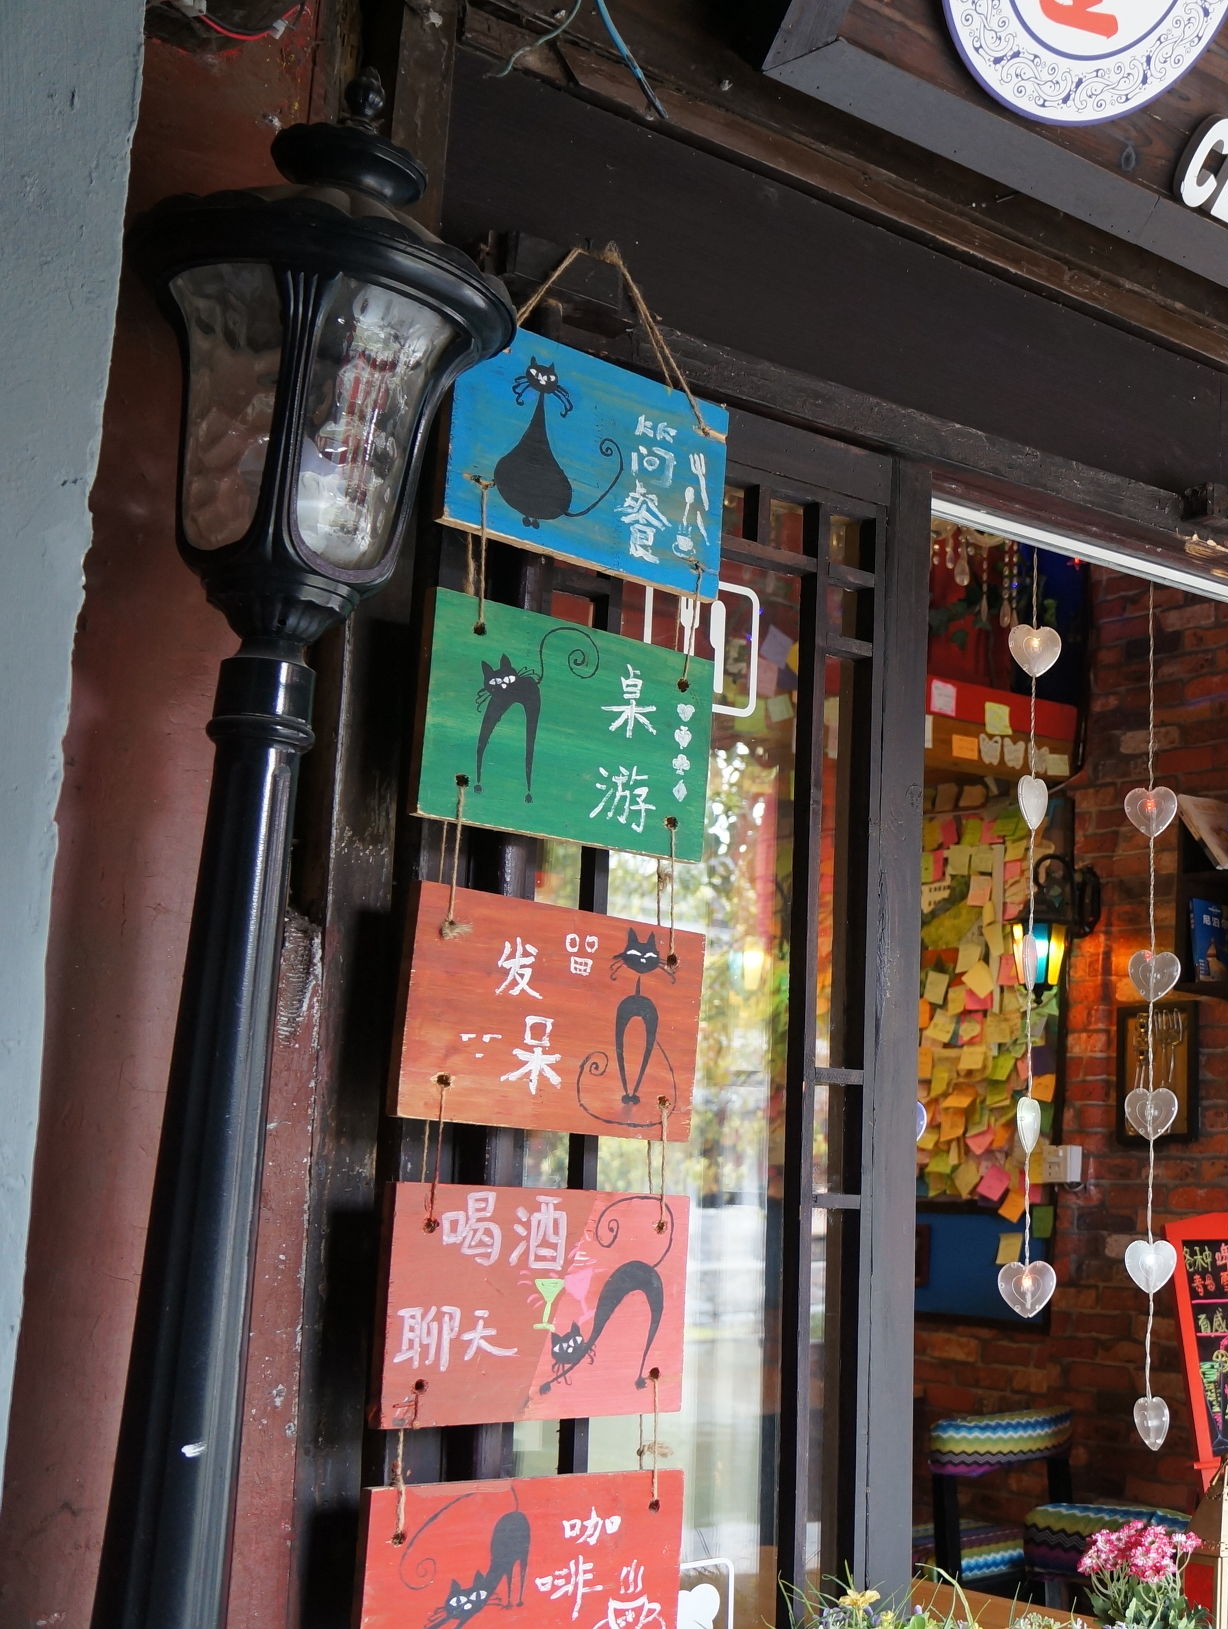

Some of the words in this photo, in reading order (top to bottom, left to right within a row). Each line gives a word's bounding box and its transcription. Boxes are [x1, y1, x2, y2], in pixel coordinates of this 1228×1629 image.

[588, 664, 657, 834] 桌游
[495, 936, 563, 1095] 发呆
[441, 1190, 568, 1271] 喝酒
[393, 1305, 519, 1372] 聊天
[534, 1506, 622, 1622] 咖啡
